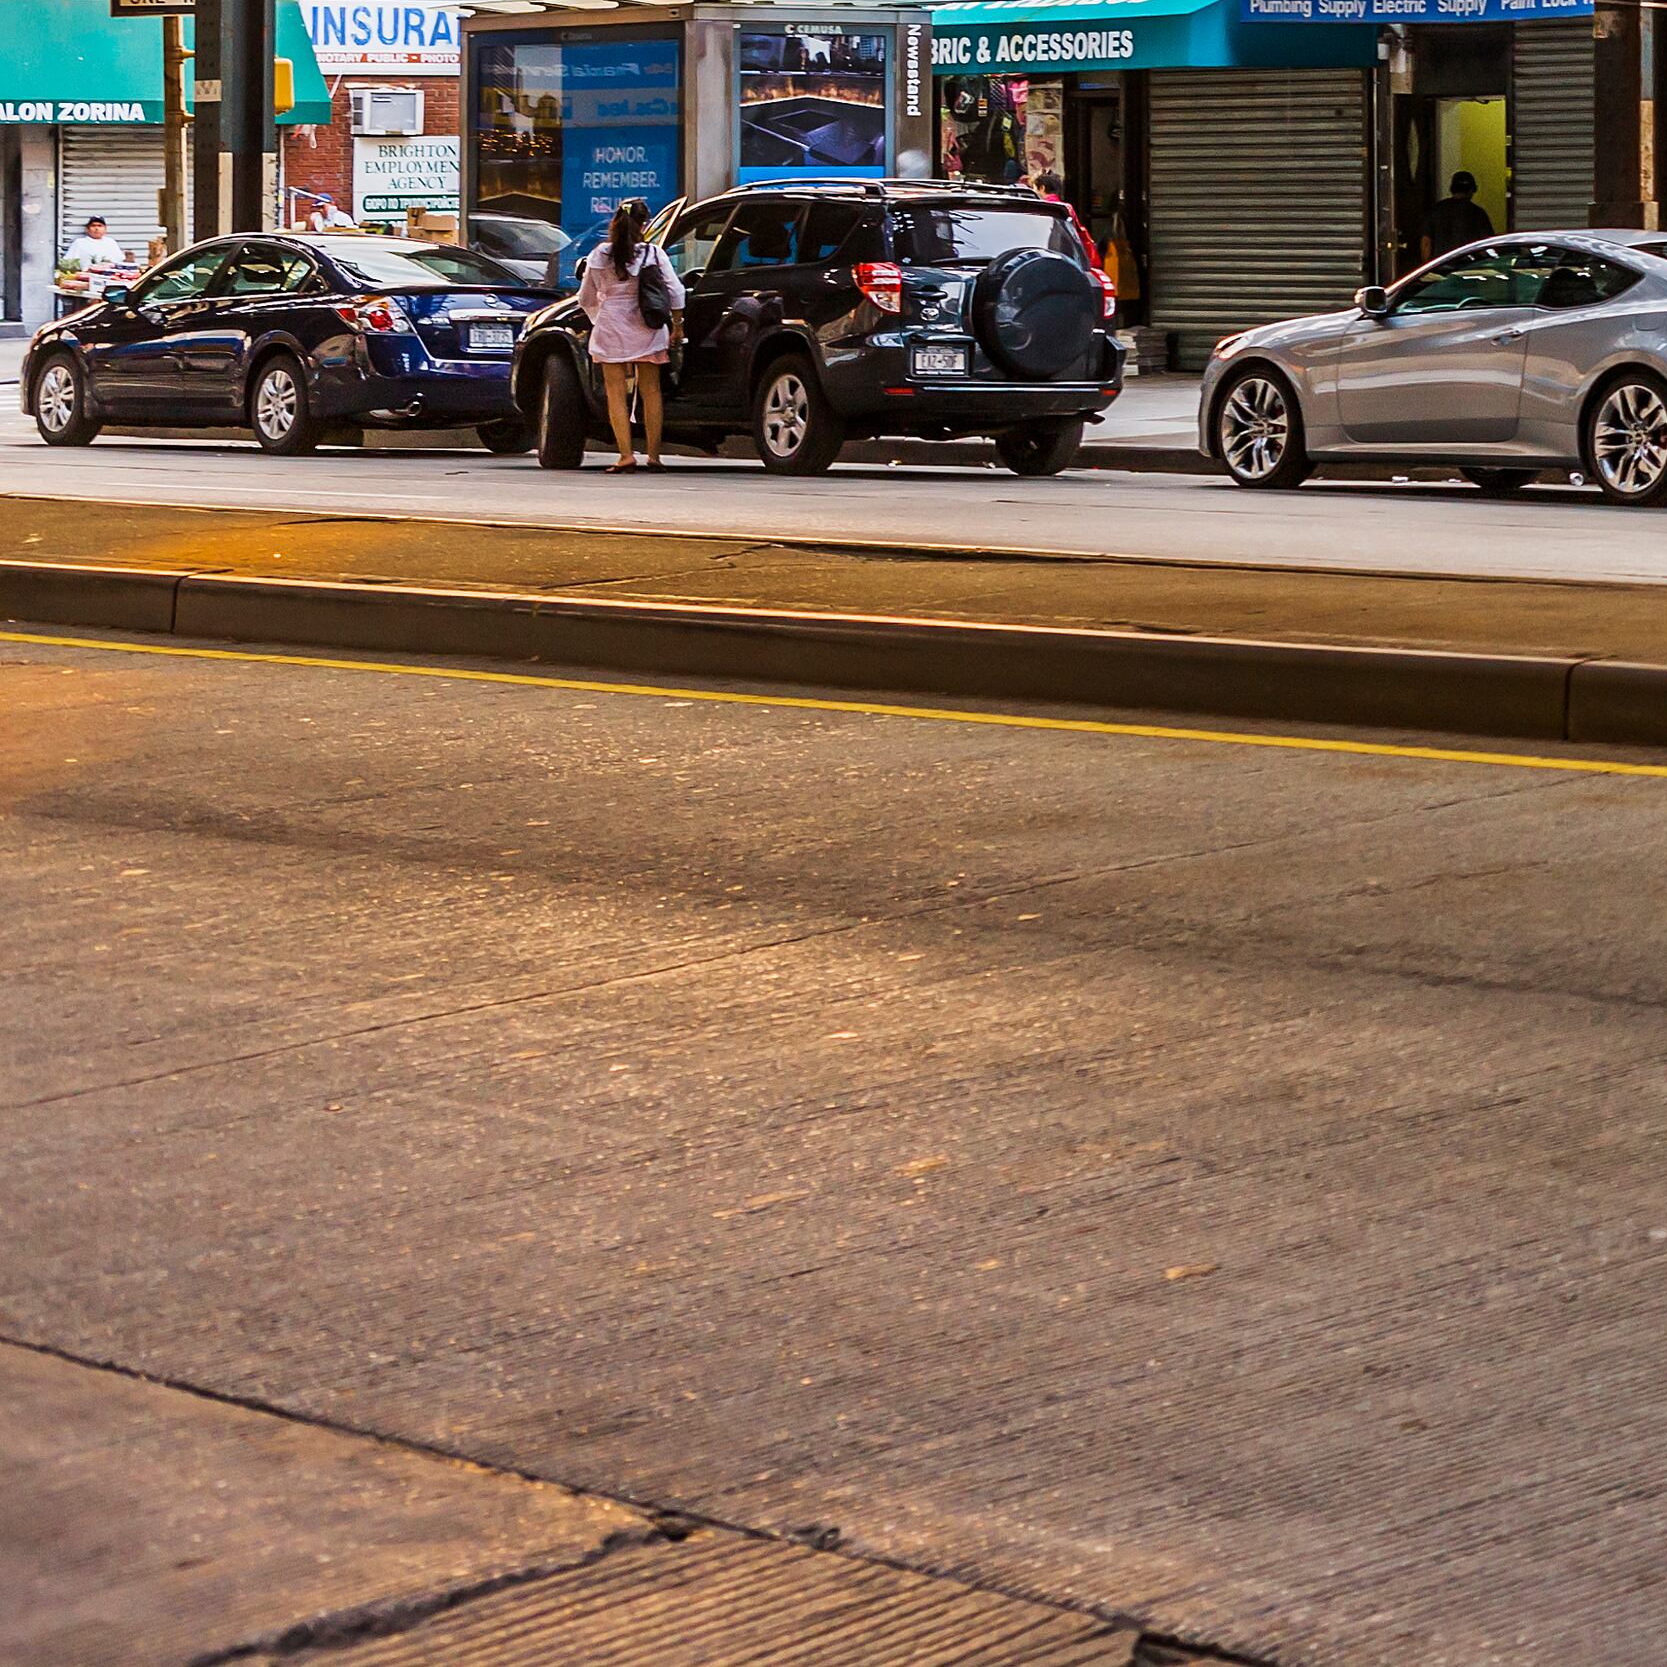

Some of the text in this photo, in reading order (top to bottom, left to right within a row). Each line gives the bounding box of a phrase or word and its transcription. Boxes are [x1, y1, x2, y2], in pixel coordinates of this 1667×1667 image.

[976, 30, 1134, 64] & ACCESSORIES
[367, 53, 409, 63] PUBLIC
[57, 103, 146, 122] ZORINA
[378, 145, 457, 158] BRIGHTON
[594, 146, 648, 164] HONOR.
[364, 160, 460, 174] EMPLOYMEN
[388, 176, 447, 190] AGENCY
[583, 171, 660, 189] REMEMBER.
